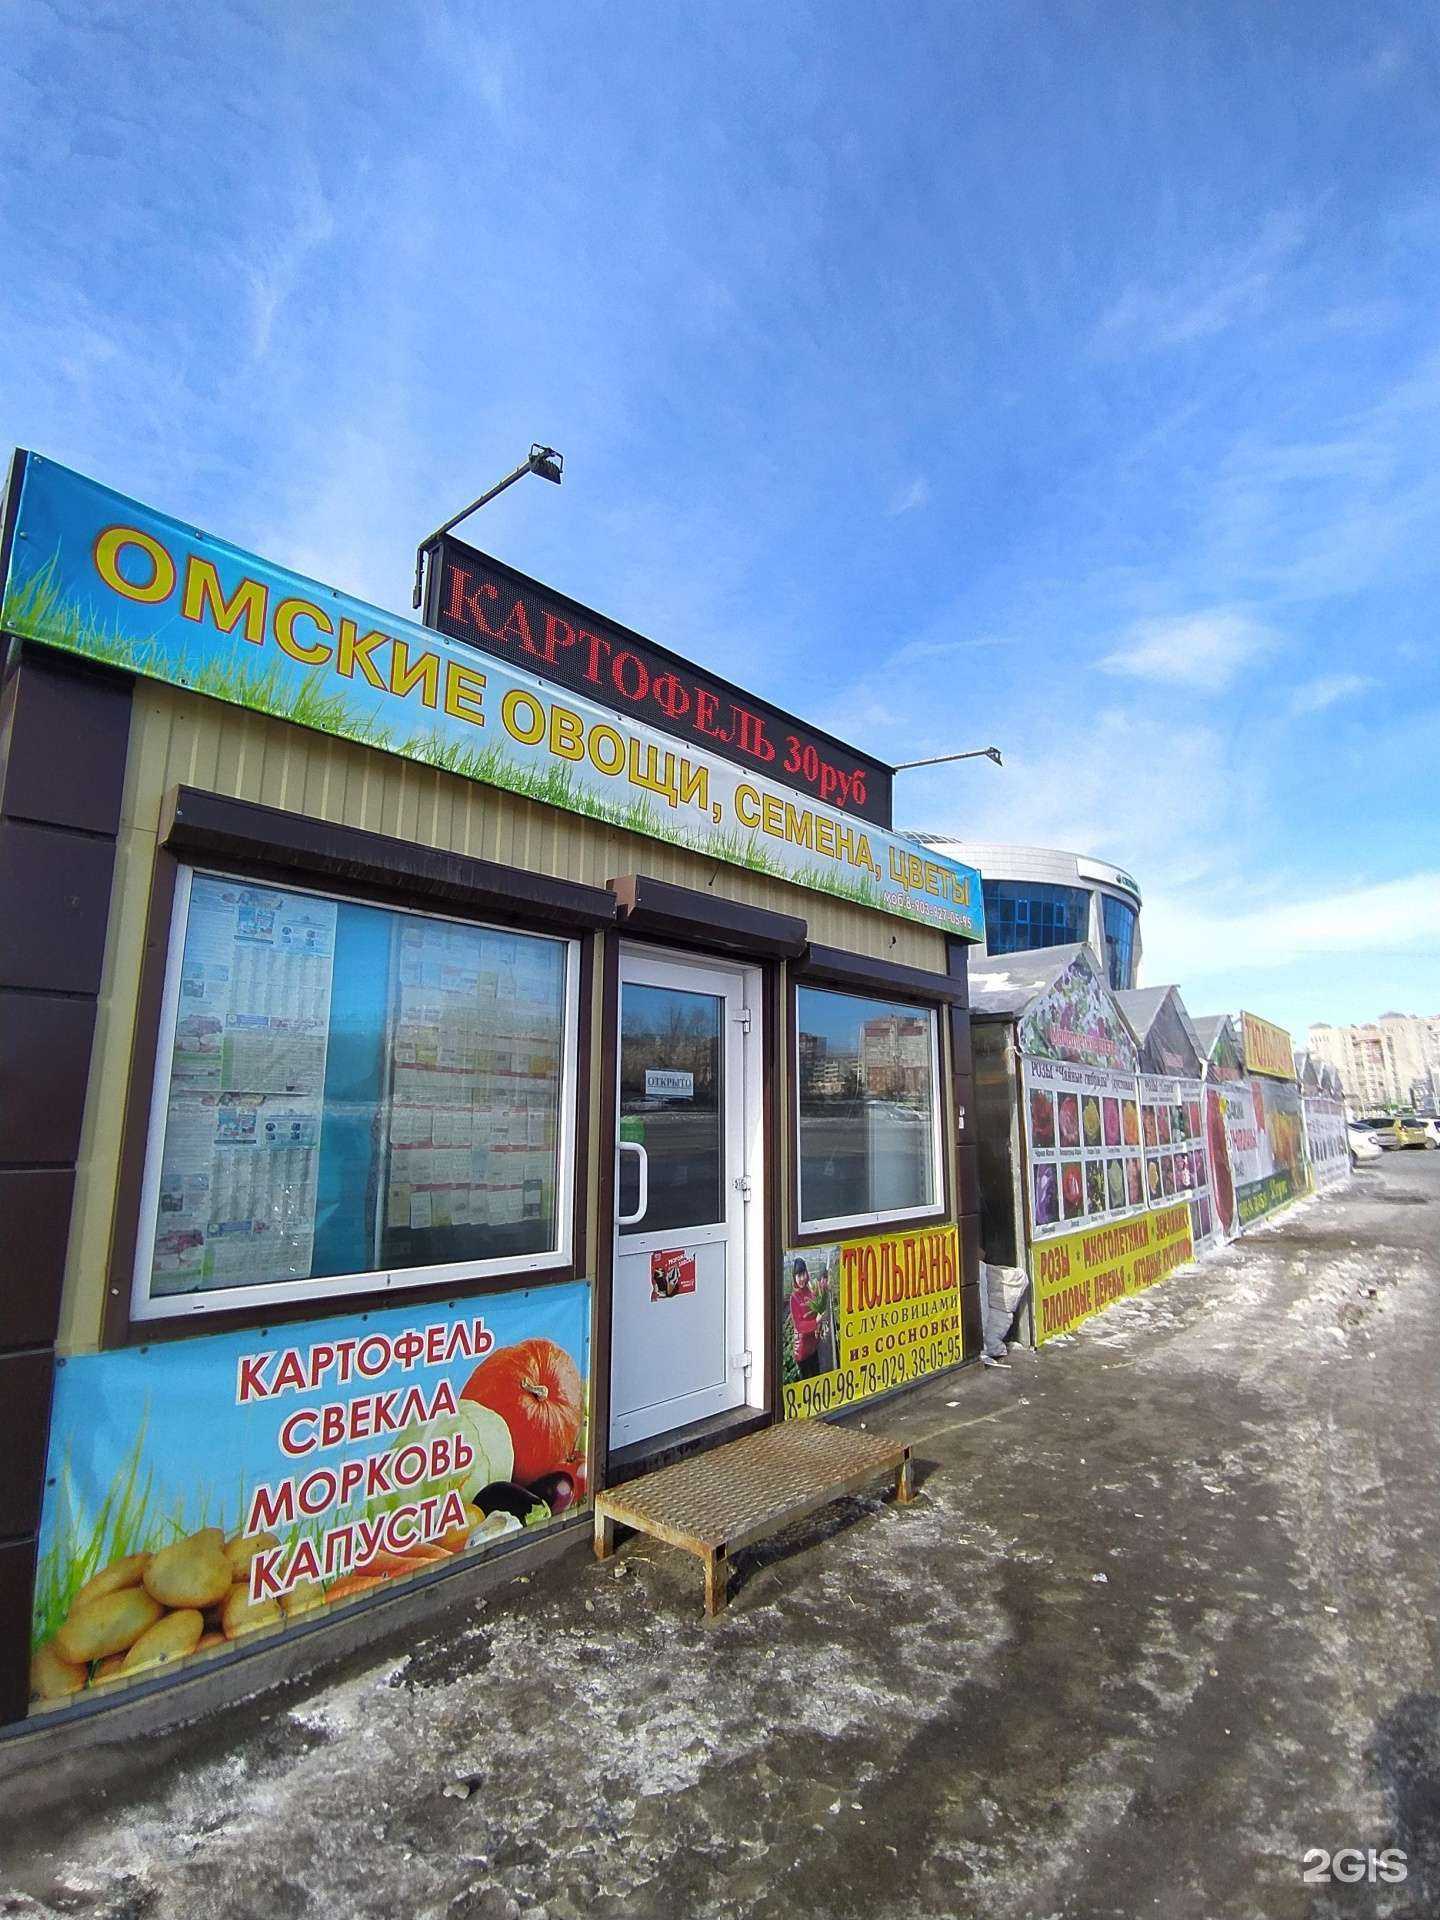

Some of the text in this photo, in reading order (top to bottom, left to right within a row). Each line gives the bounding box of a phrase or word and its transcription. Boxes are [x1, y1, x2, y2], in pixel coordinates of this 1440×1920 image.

[443, 564, 776, 761] КАРТОФЕЛЬ
[94, 526, 970, 907] ОМСКИЕ ОВОЩИ, СЕМЕНА, ЦВЕТЫ
[647, 1076, 692, 1089] ОТКРЫТО
[842, 1231, 957, 1314] ТЮЛЬПАНЫ
[1040, 1244, 1070, 1287] РОЗЫ
[1083, 1219, 1150, 1269] МНОГОЛЕТНИКИ
[845, 1296, 958, 1338] С ЛУКОВИЦАМИ
[875, 1315, 959, 1353] СОСНОВКИ
[1042, 1280, 1091, 1333] ПЛОДОВЫЕ
[1094, 1265, 1125, 1312] ДЕРЕВЬЯ
[237, 1319, 495, 1400] КАРТОФЕЛЬ
[280, 1379, 457, 1455] СВЕКЛА
[243, 1434, 473, 1537] МОРКОВЬ
[249, 1492, 466, 1604] КАПУСТА
